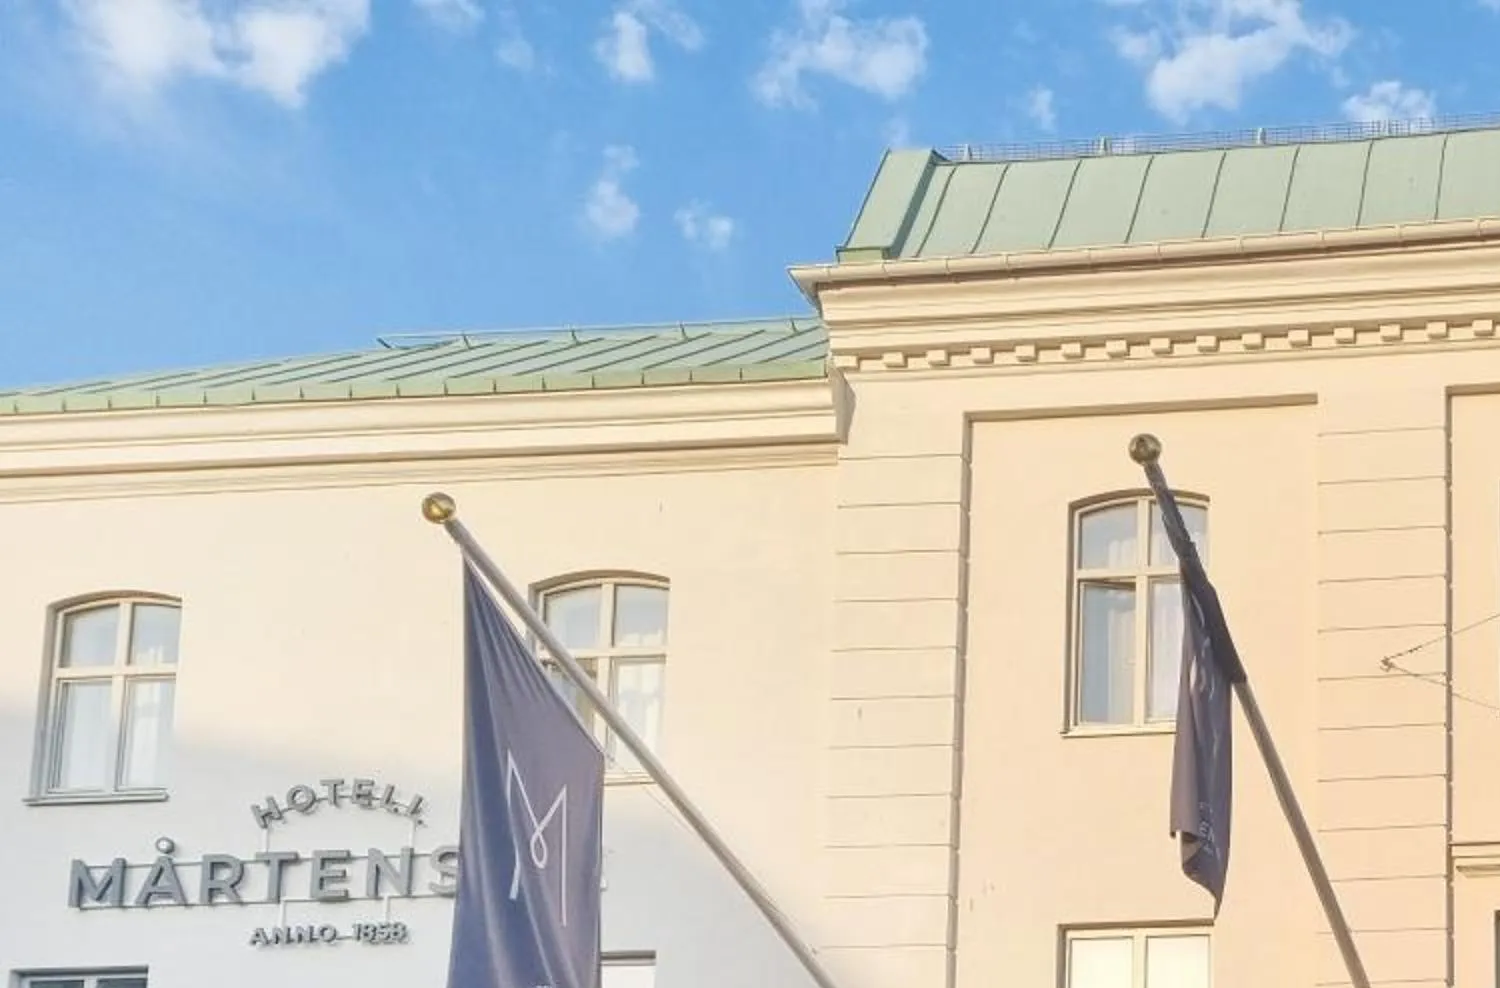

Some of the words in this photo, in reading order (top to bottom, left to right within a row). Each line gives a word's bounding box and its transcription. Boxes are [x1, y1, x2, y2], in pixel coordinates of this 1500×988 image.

[251, 778, 426, 828] HOTELL
[67, 837, 460, 908] MÅRTENS
[250, 925, 338, 946] ANNO
[353, 921, 409, 945] 1858
